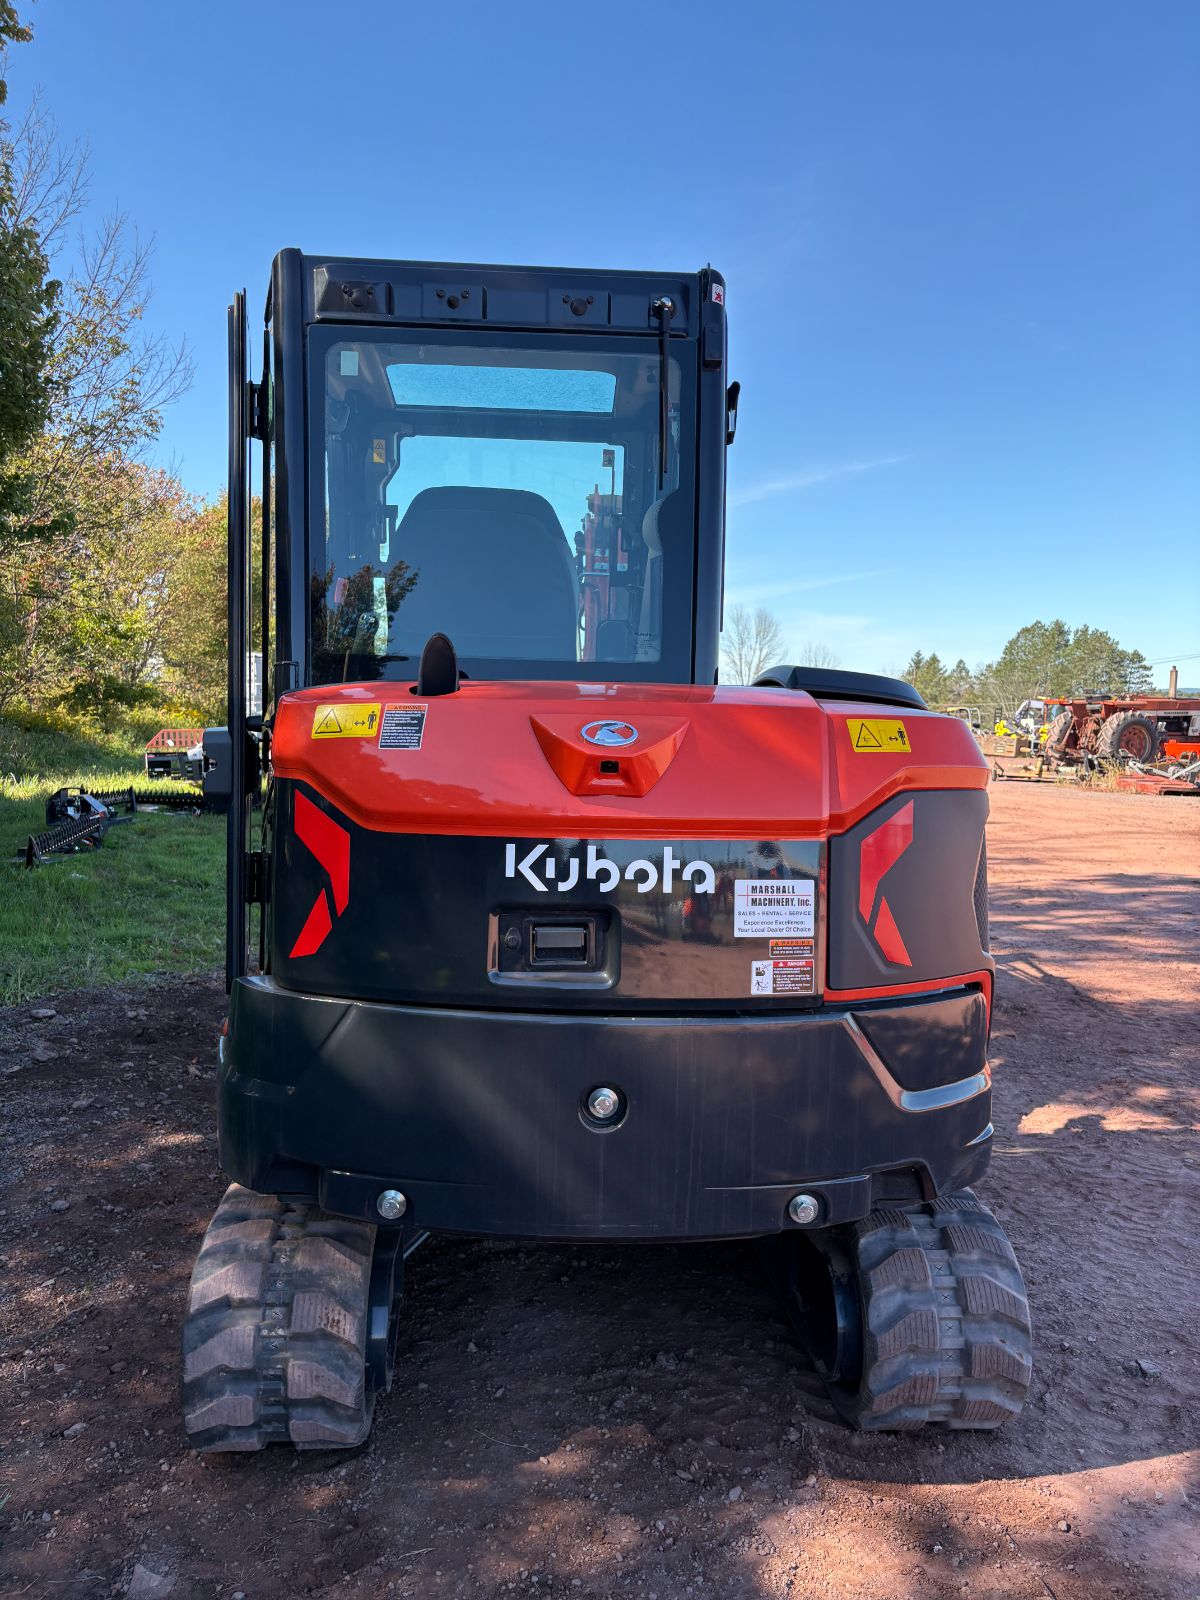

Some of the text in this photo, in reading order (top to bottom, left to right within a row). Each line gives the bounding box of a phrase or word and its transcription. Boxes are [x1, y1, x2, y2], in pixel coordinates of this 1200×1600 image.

[505, 843, 715, 894] Kubota
[751, 885, 796, 894] MARSHALL
[751, 898, 812, 907] MACHINERY, Inc.
